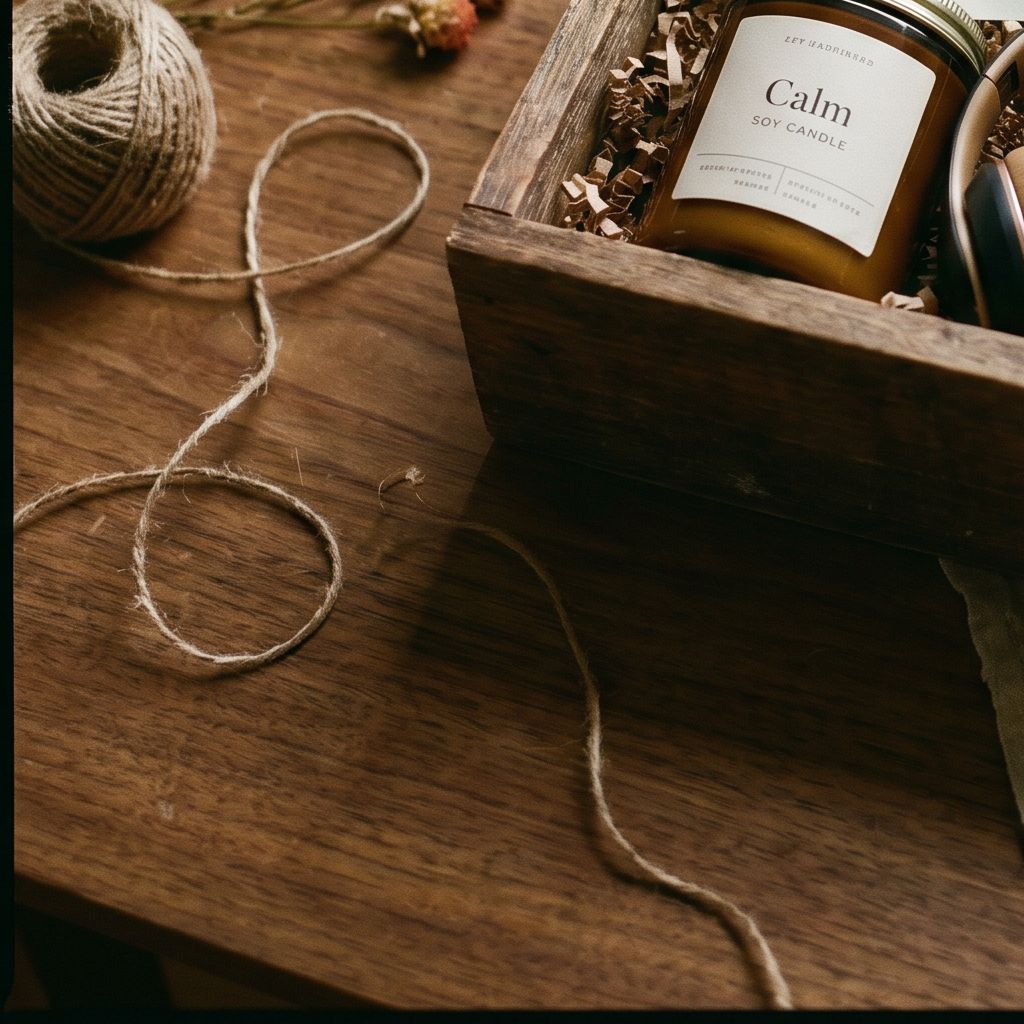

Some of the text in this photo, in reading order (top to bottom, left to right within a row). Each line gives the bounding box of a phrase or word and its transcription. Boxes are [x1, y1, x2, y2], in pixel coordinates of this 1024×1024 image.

[765, 78, 853, 128] Calm
[751, 115, 847, 151] SOY CANDLE
